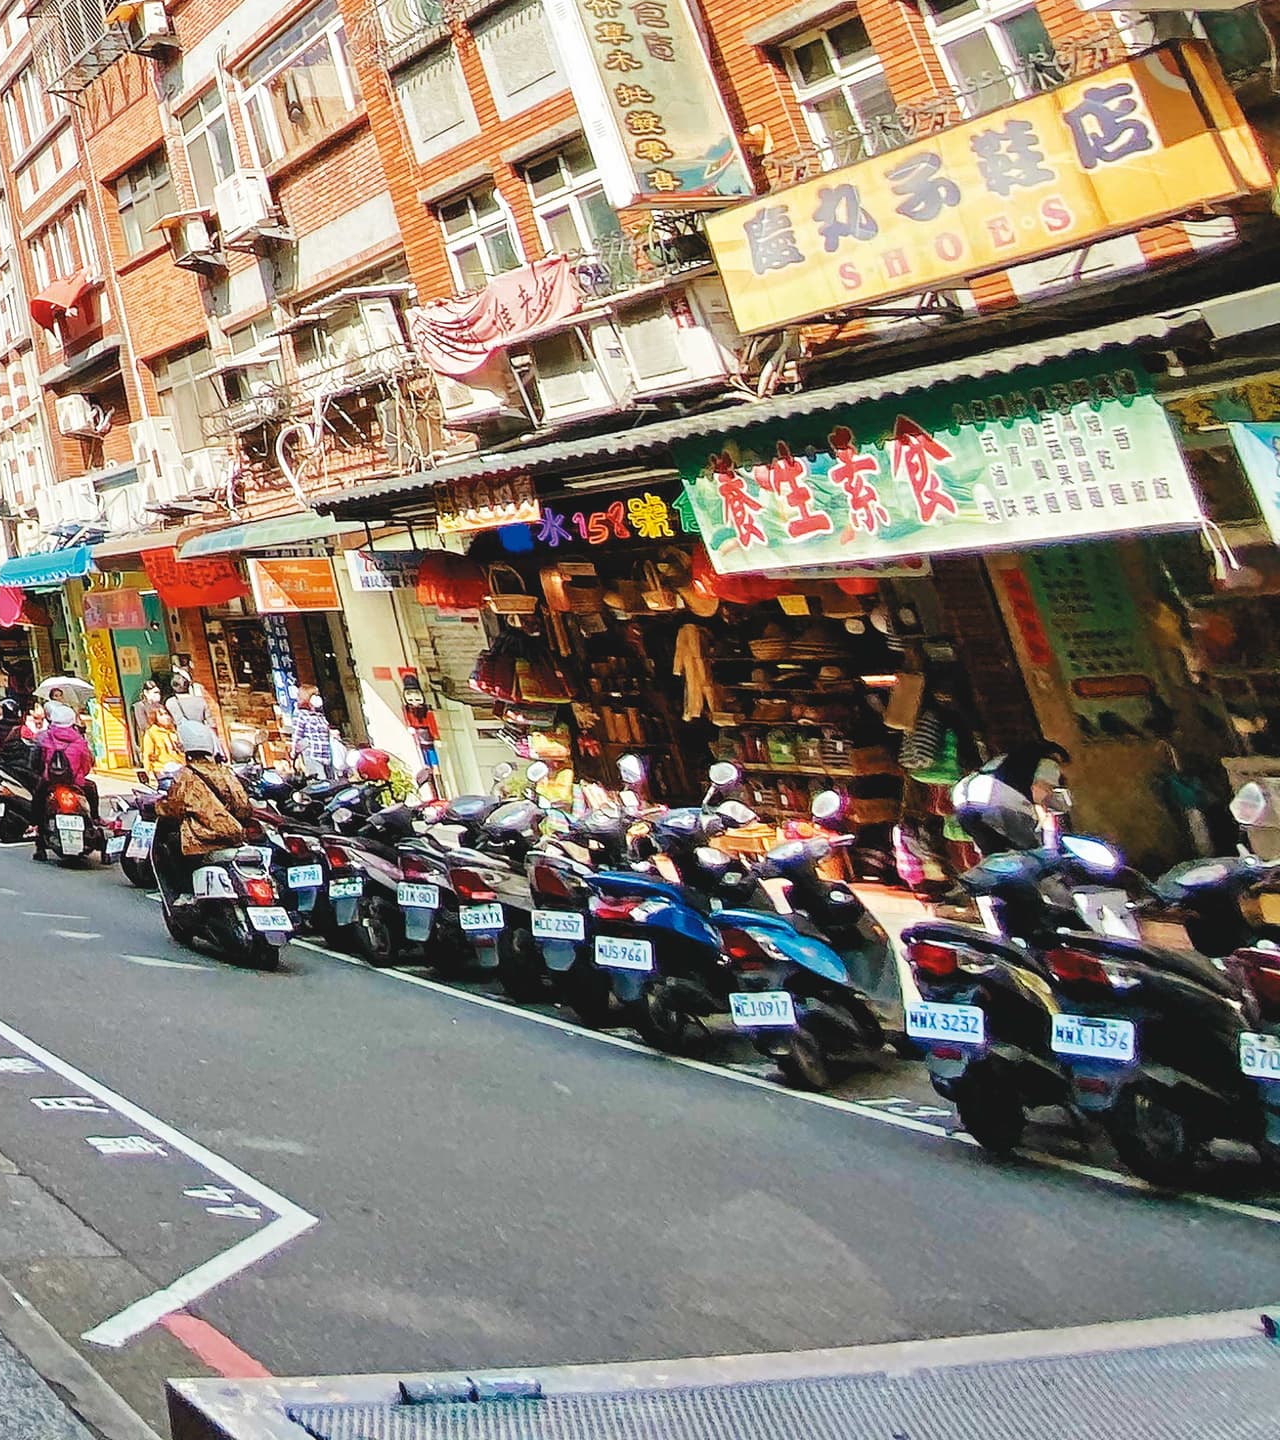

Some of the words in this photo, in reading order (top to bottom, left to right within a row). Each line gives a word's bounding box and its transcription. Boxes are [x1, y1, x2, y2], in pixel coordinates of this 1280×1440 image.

[742, 84, 1162, 277] 慶丸子鞋店
[710, 415, 963, 550] 養生素食
